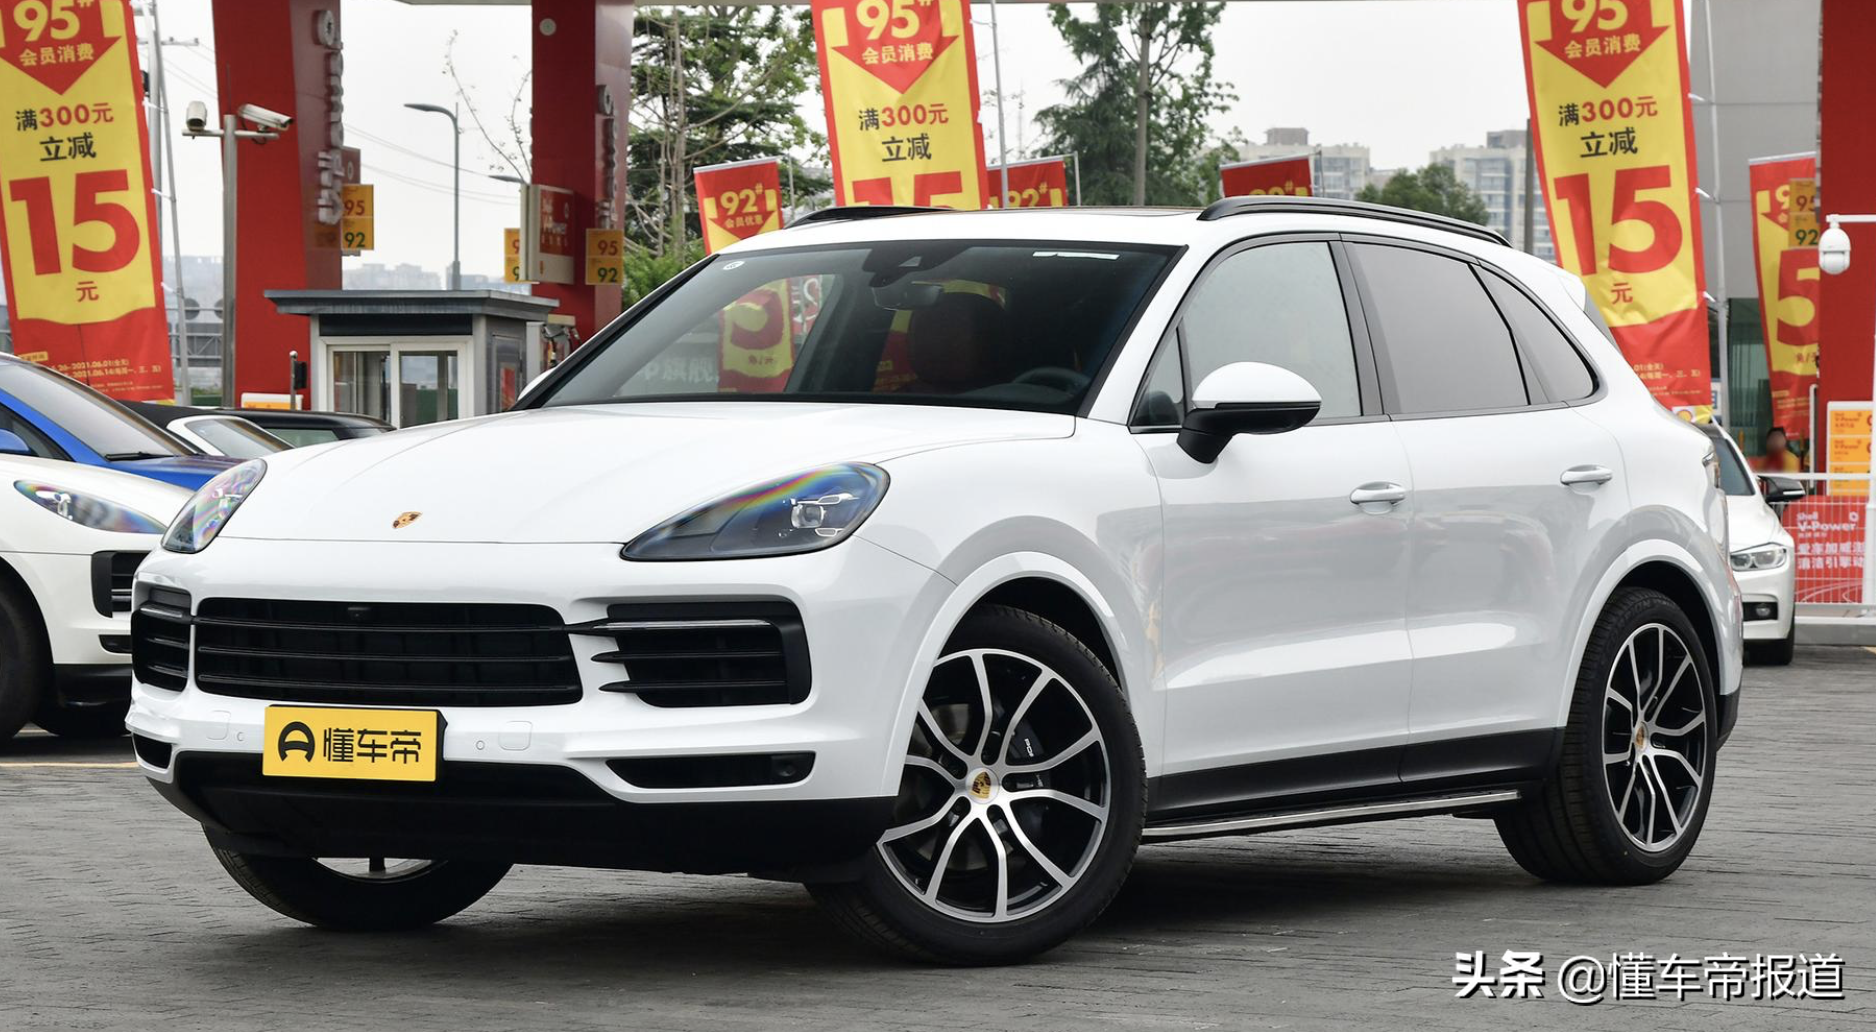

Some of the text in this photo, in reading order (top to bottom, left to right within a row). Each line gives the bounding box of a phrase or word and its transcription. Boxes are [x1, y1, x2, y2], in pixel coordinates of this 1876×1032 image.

[18, 43, 94, 67] 会员消费
[862, 43, 933, 65] 会员消费
[1564, 33, 1641, 59] 会员消费
[15, 103, 114, 131] 满300元
[858, 103, 949, 131] 满300元
[1558, 96, 1658, 127] 满300元
[39, 132, 97, 161] 立减
[881, 133, 932, 162] 立减
[1580, 127, 1638, 158] 立减
[344, 200, 365, 216] 95
[720, 182, 763, 215] 92#
[9, 169, 140, 276] 15
[1553, 165, 1683, 276] 15
[344, 232, 365, 248] 92
[598, 240, 618, 256] 95
[1795, 229, 1818, 246] 92
[598, 268, 618, 283] 92
[76, 281, 99, 302] 元
[1611, 282, 1634, 305] 元
[1797, 520, 1857, 532] V-Power
[323, 727, 422, 764] 懂车帝
